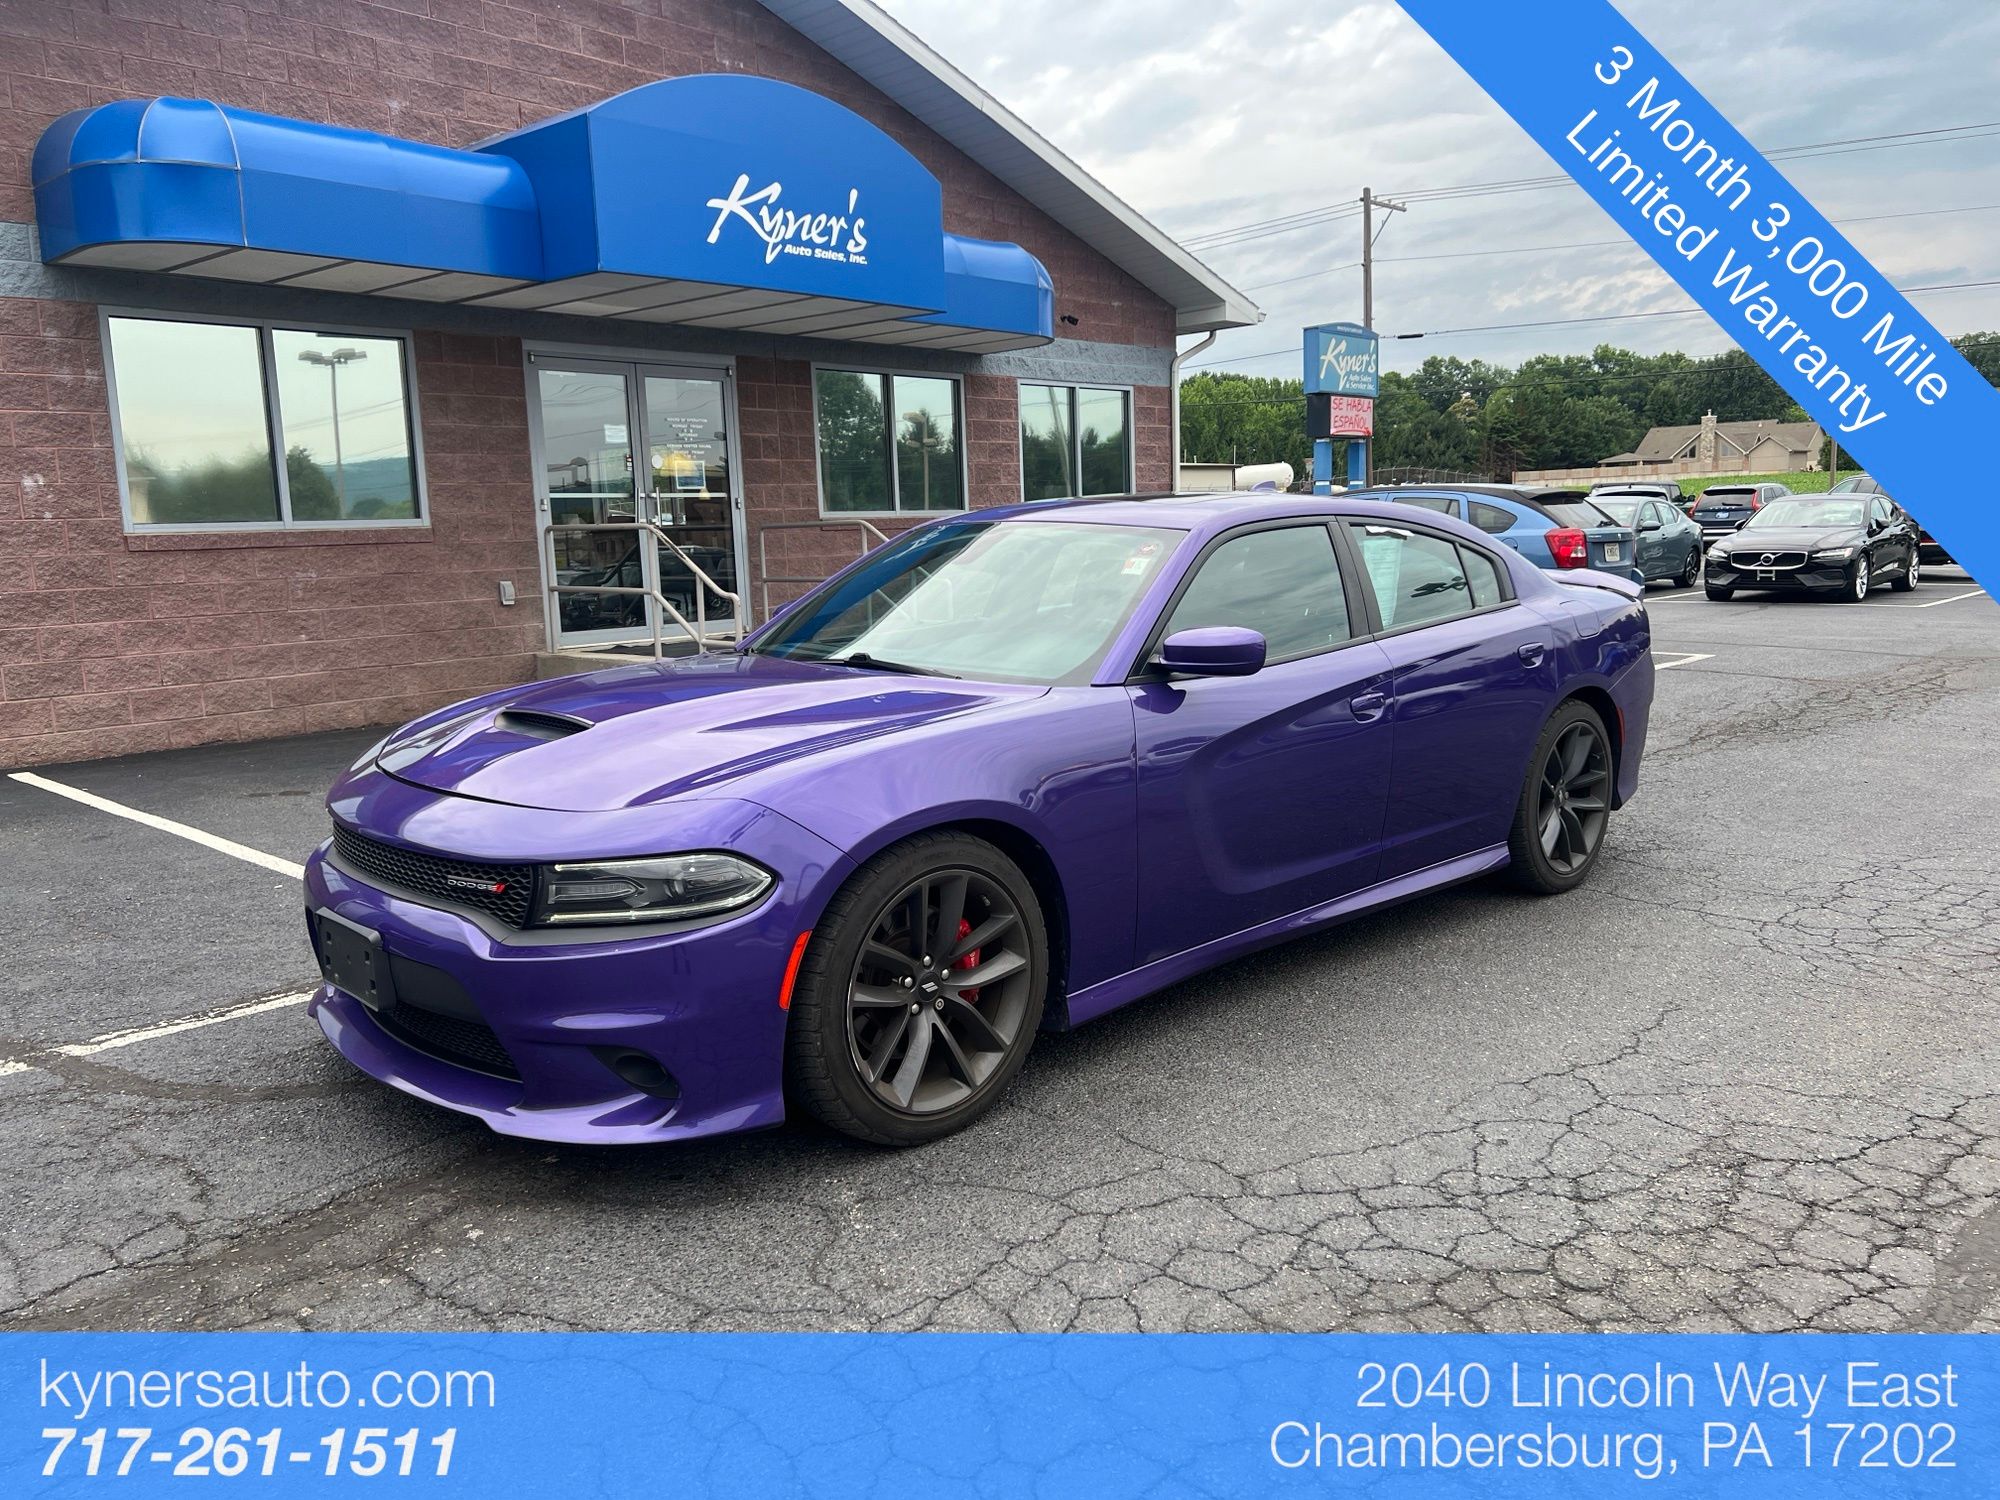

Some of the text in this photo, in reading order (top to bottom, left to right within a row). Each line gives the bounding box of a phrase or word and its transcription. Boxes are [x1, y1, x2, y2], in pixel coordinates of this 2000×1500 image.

[706, 173, 868, 264] Kyner's
[784, 244, 868, 265] Auto Sales, Inc.
[1320, 337, 1376, 391] Kyner's
[1332, 398, 1371, 412] SE HABLA
[1333, 414, 1368, 430] ESPAÑOL
[447, 879, 497, 892] DODGE
